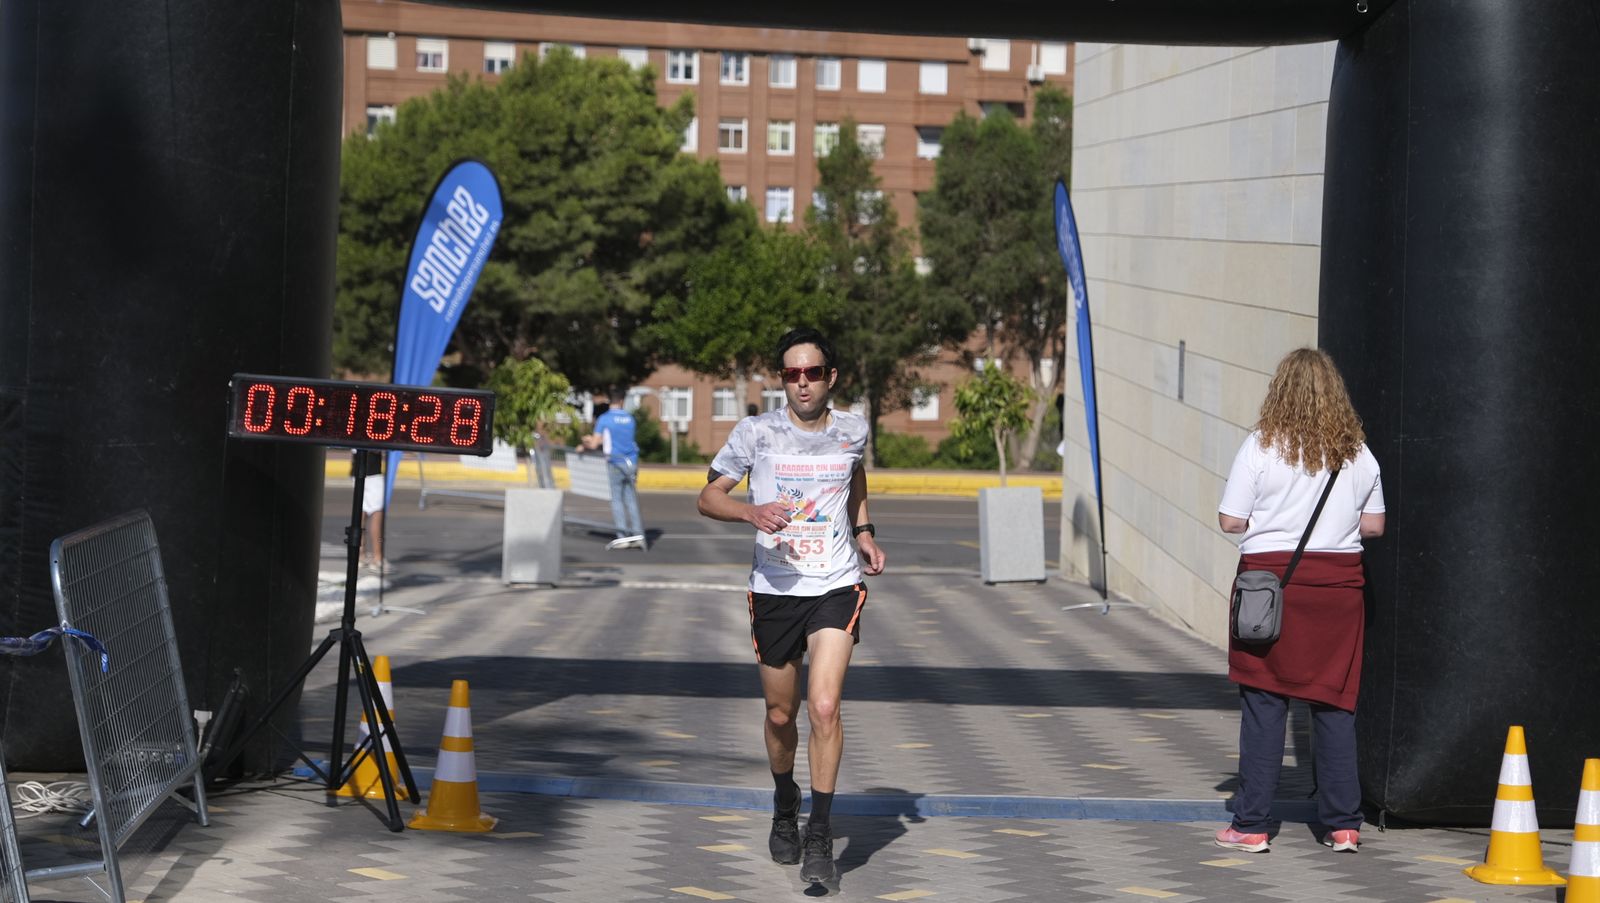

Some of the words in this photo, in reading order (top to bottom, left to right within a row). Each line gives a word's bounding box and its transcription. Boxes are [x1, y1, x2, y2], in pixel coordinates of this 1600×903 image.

[244, 383, 481, 446] 00:18:28
[782, 464, 814, 472] CARRERA
[816, 463, 829, 472] SIN
[773, 537, 825, 555] 1153
